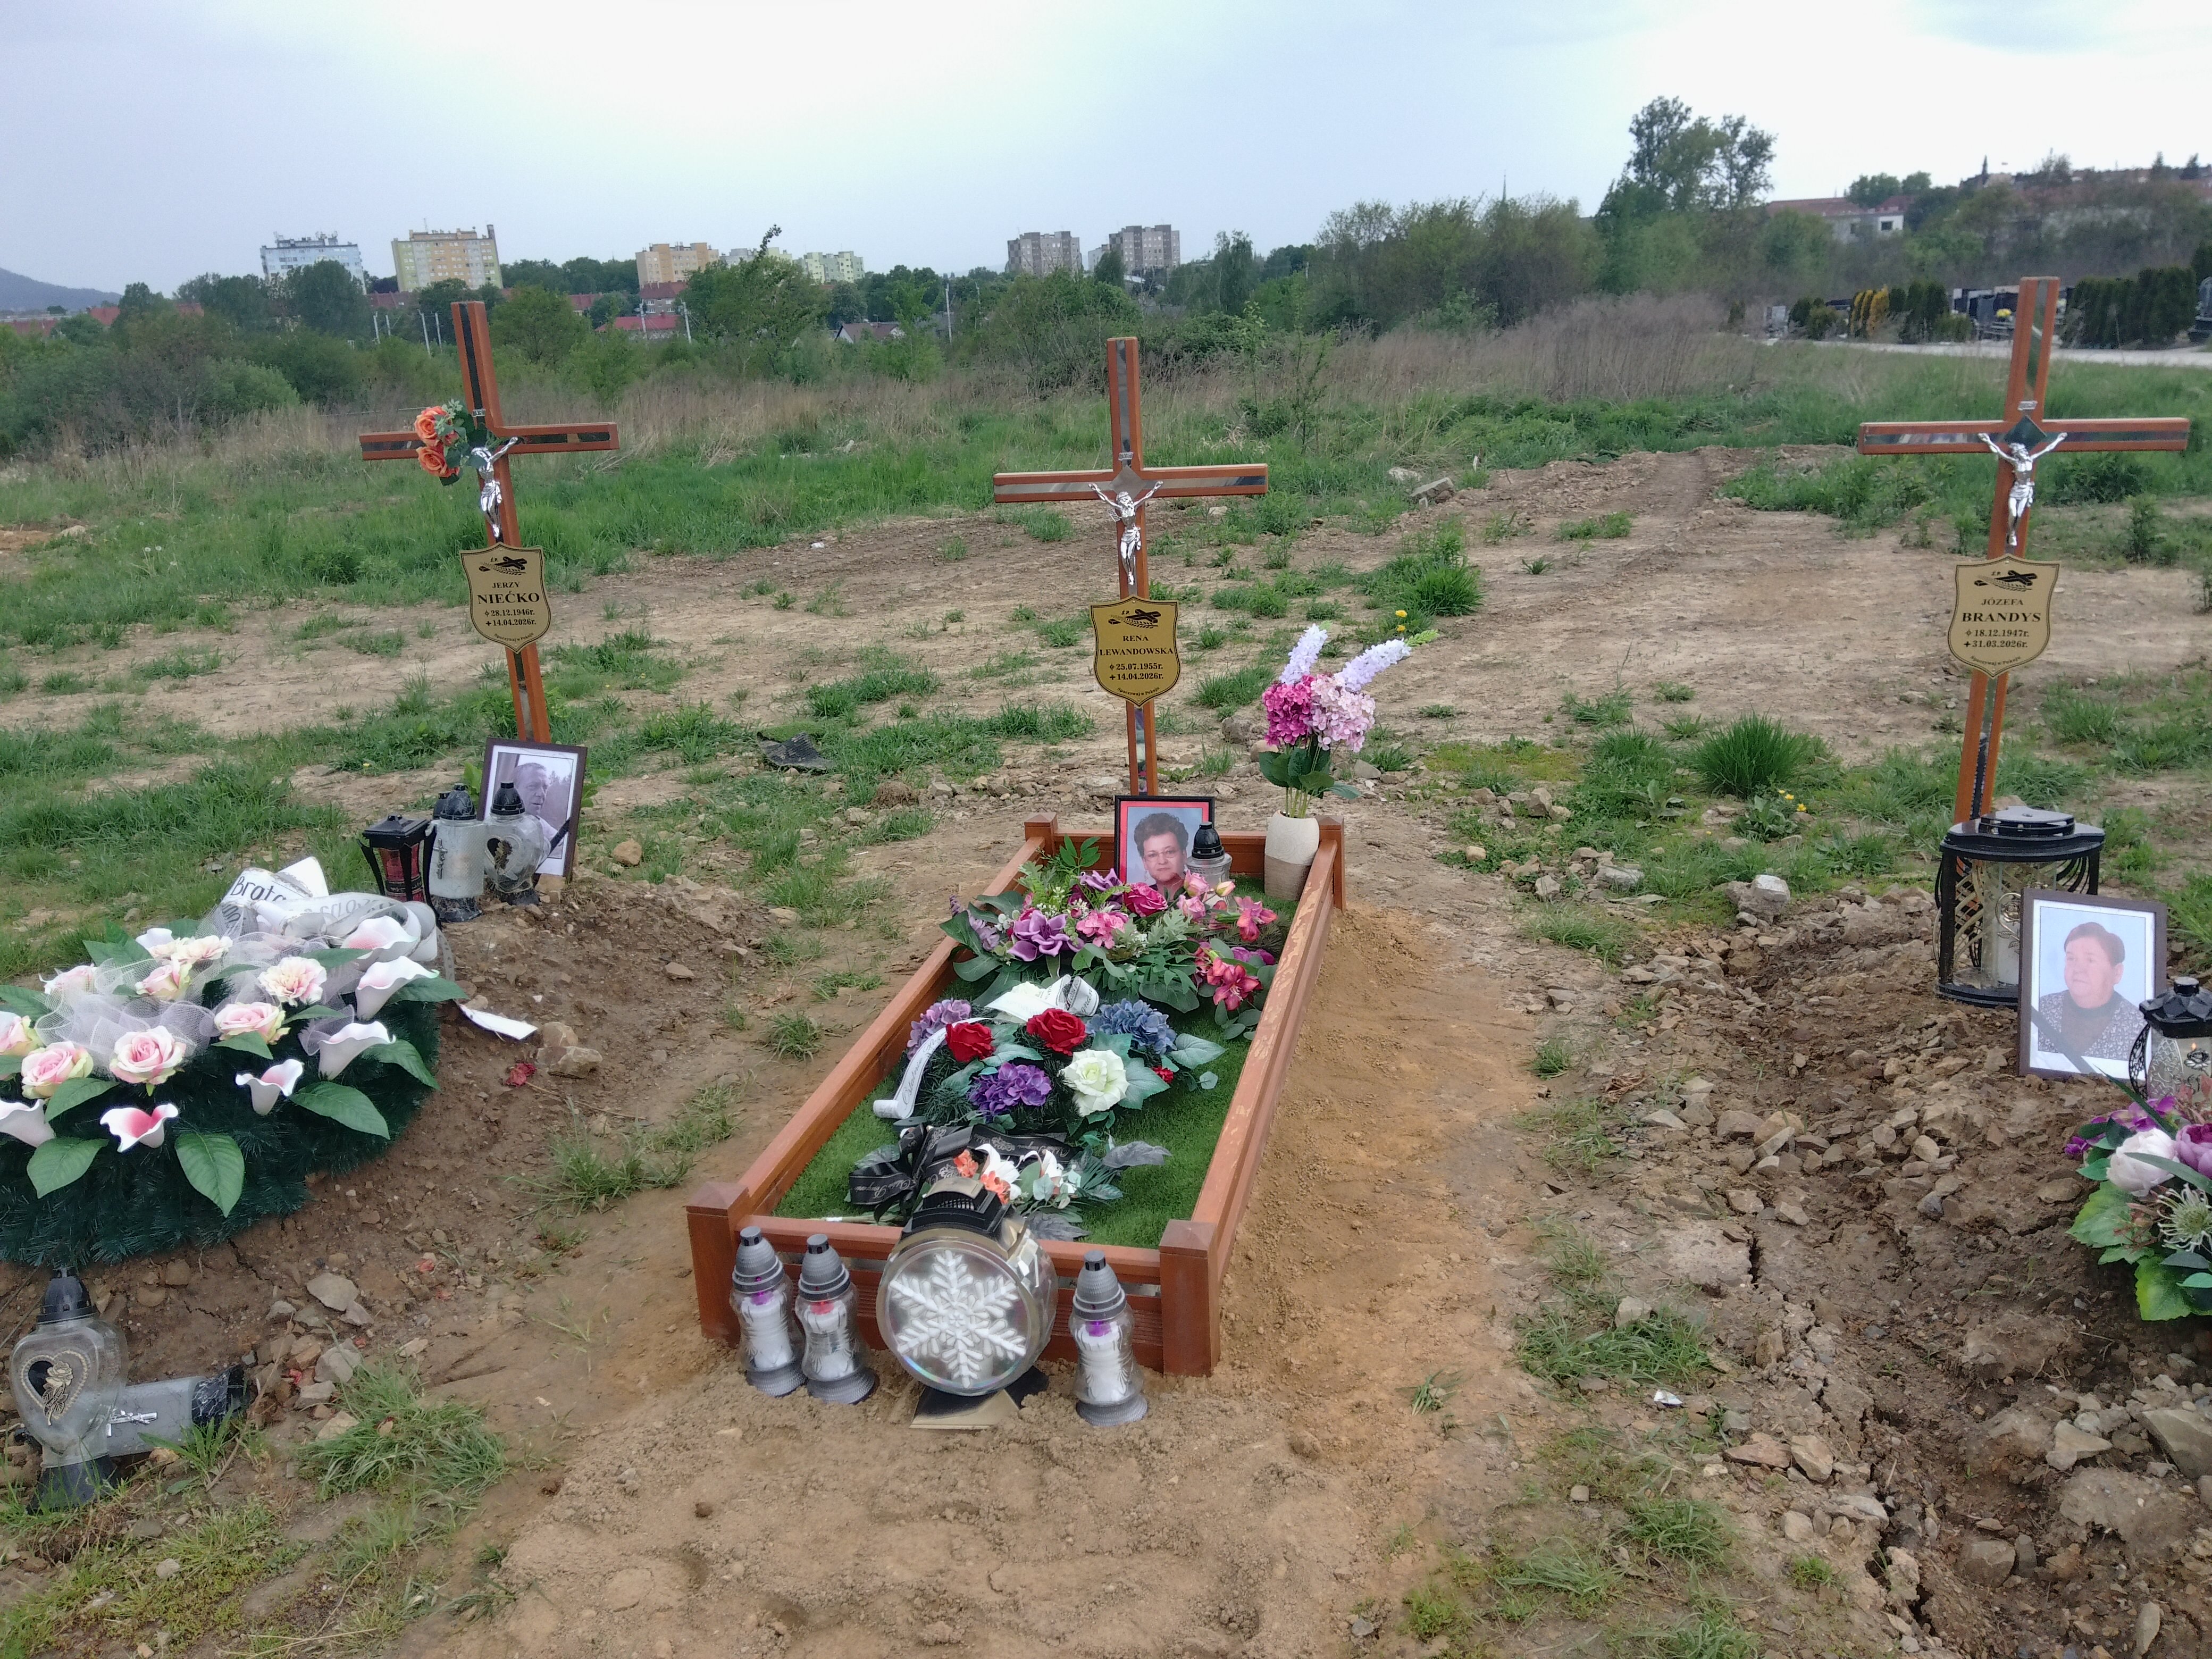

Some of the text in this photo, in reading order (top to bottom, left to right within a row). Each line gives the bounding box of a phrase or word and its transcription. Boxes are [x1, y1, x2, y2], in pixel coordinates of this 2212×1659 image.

[477, 591, 540, 604] NIEĆKO
[1981, 597, 2024, 606] JÓZEFA
[1962, 613, 2041, 622] BRANDYS
[1100, 647, 1174, 656] LEWANDOWSKA
